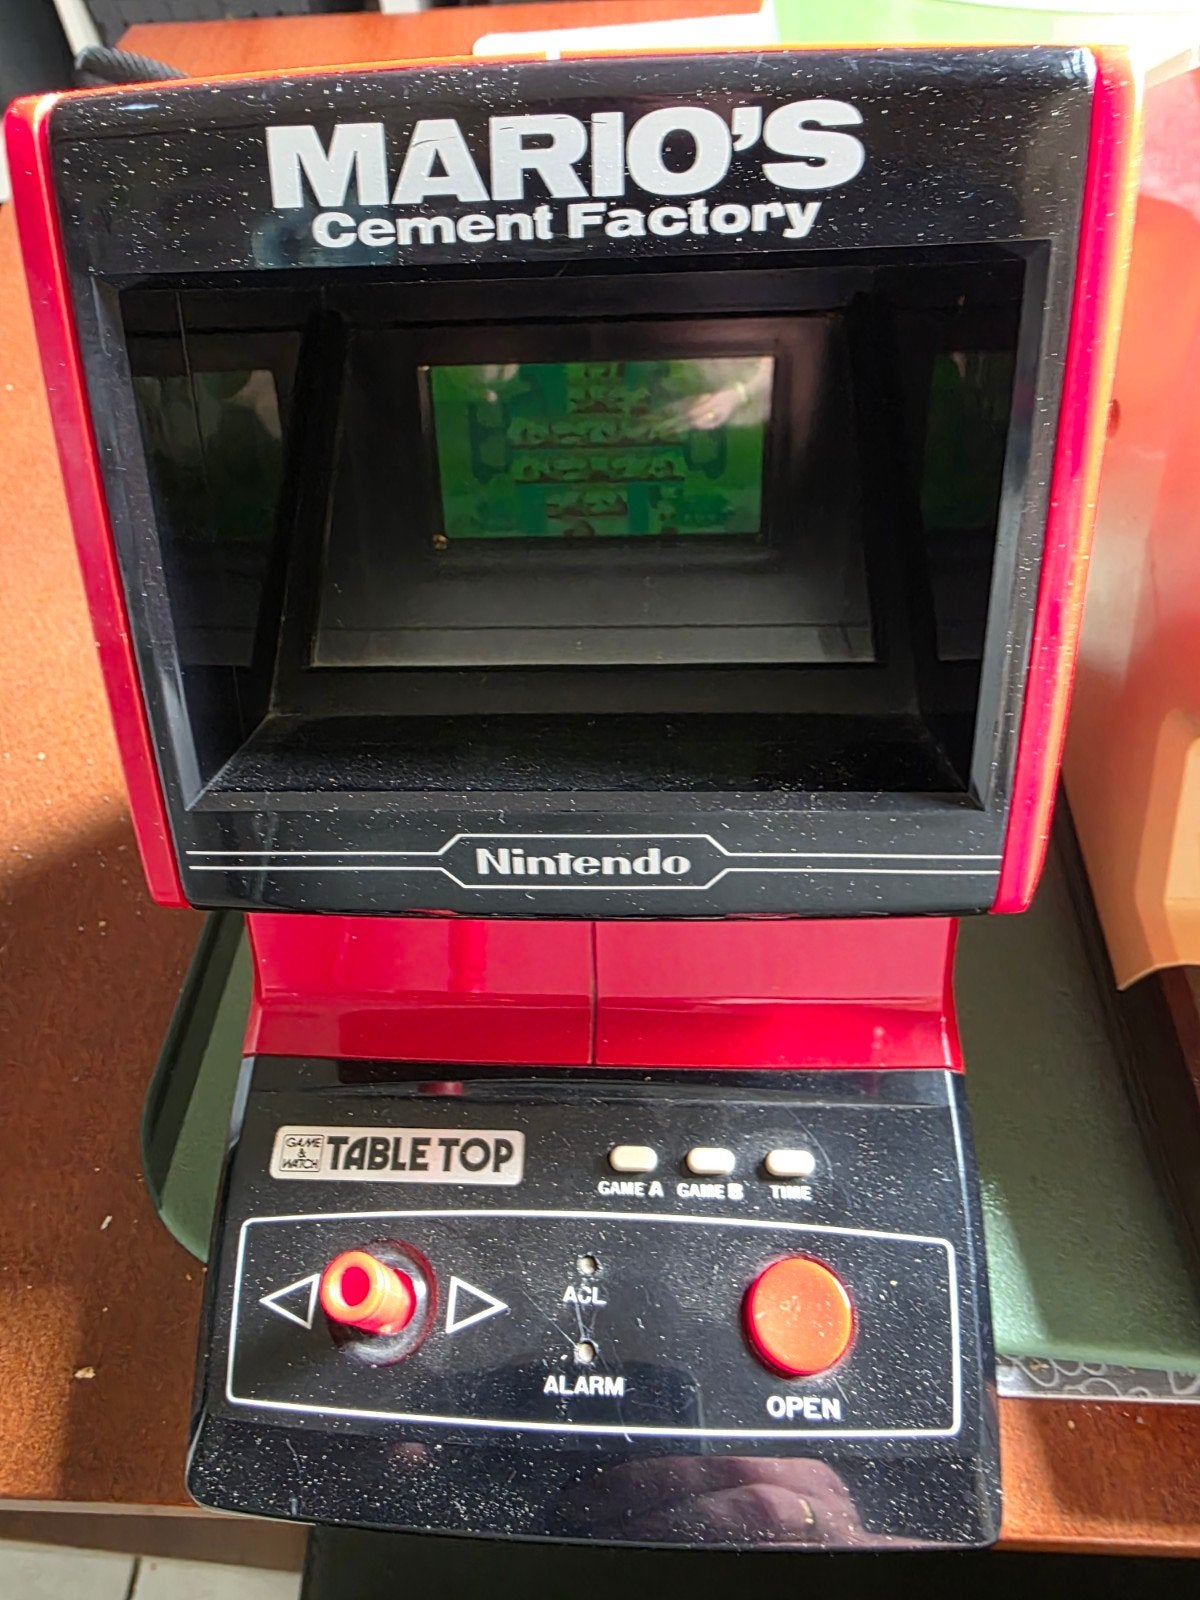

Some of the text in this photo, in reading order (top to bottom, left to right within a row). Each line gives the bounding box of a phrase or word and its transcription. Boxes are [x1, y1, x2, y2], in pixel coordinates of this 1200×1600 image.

[266, 99, 865, 209] MARIO'S
[312, 198, 823, 249] Cement Factory
[475, 848, 692, 876] Nintendo
[285, 1137, 322, 1148] GAME
[281, 1158, 319, 1170] WATCH
[597, 1181, 664, 1198] GAME A
[676, 1183, 744, 1200] GAME B
[769, 1185, 812, 1201] TIME
[562, 1285, 606, 1305] ACL
[543, 1375, 625, 1398] ALARM
[766, 1396, 842, 1421] OPEN
